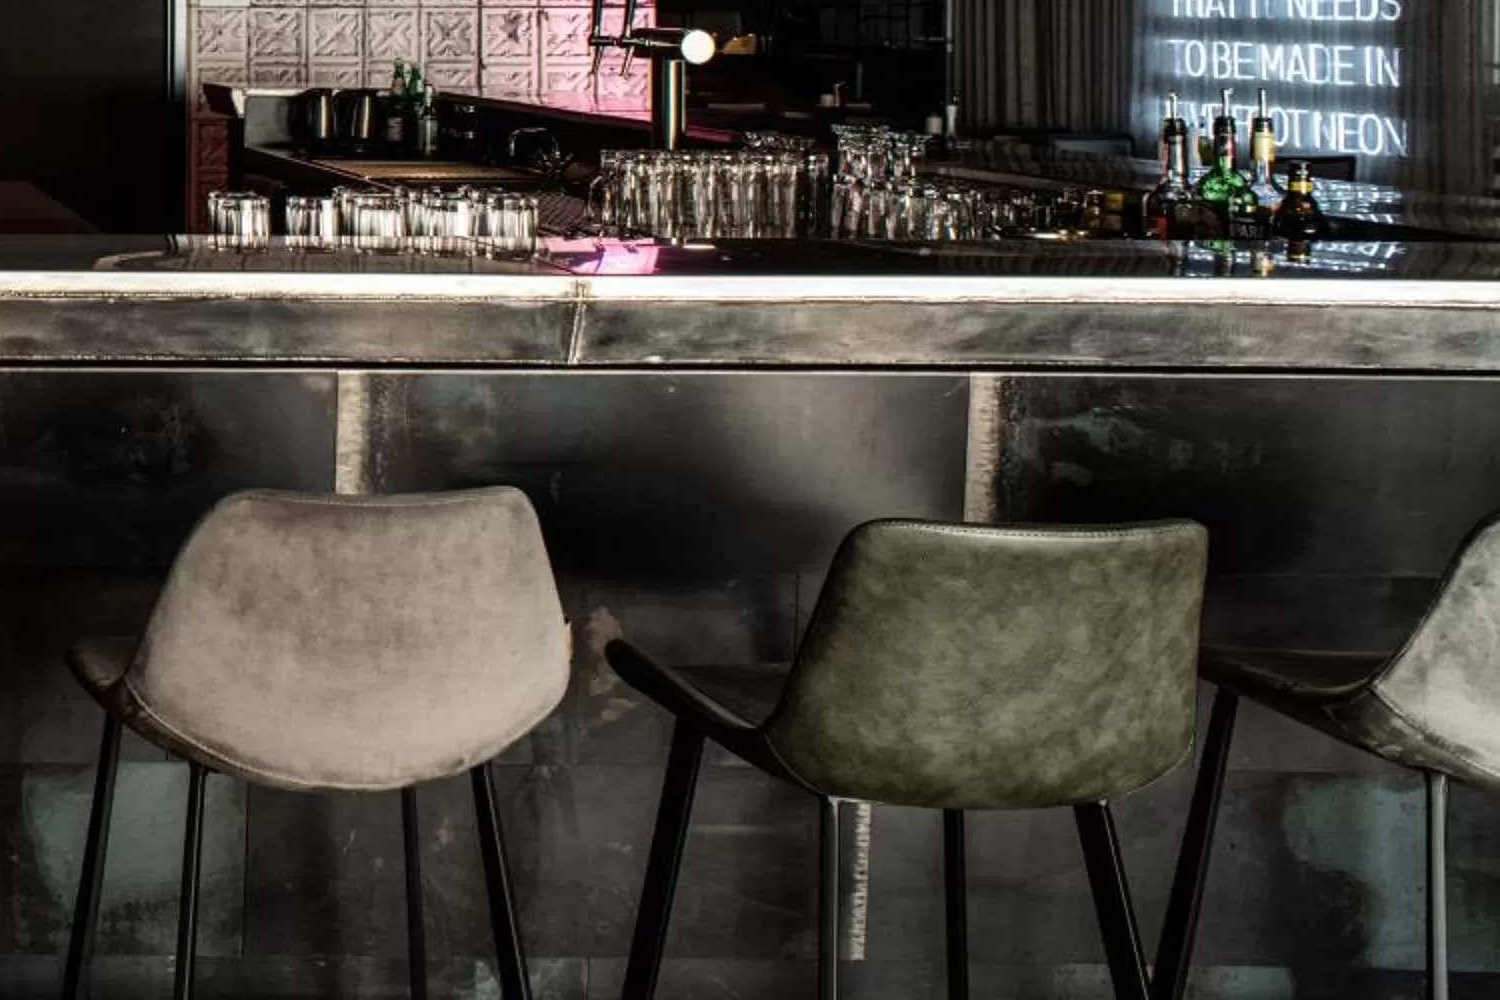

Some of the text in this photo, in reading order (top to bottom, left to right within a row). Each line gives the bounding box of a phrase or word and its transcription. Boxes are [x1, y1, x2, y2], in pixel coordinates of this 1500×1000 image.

[1166, 39, 1403, 87] TO BE MADE IN
[1313, 110, 1408, 157] NEON
